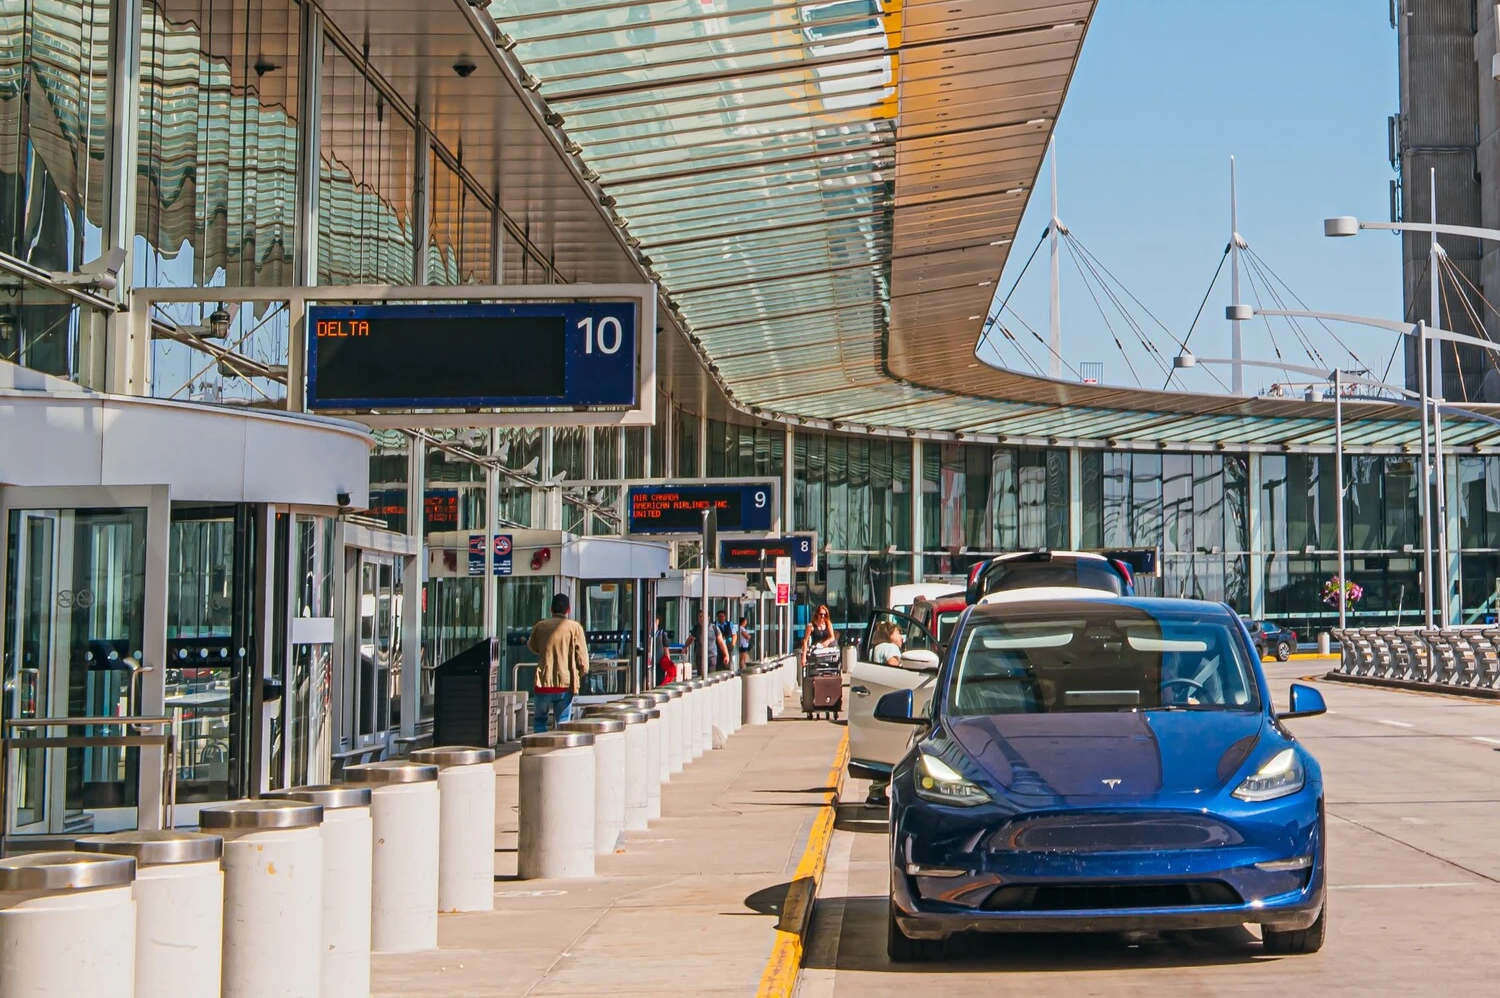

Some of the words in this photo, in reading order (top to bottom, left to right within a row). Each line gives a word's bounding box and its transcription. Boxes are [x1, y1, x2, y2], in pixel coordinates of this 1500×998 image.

[317, 321, 369, 337] DELTA
[577, 316, 623, 354] 10
[633, 493, 648, 501] AIR
[651, 493, 679, 501] CANADA
[754, 491, 766, 508] 9
[673, 501, 710, 509] AIRLINES
[633, 510, 661, 518] UNITED
[801, 541, 809, 552] 8
[1146, 553, 1152, 562] 7
